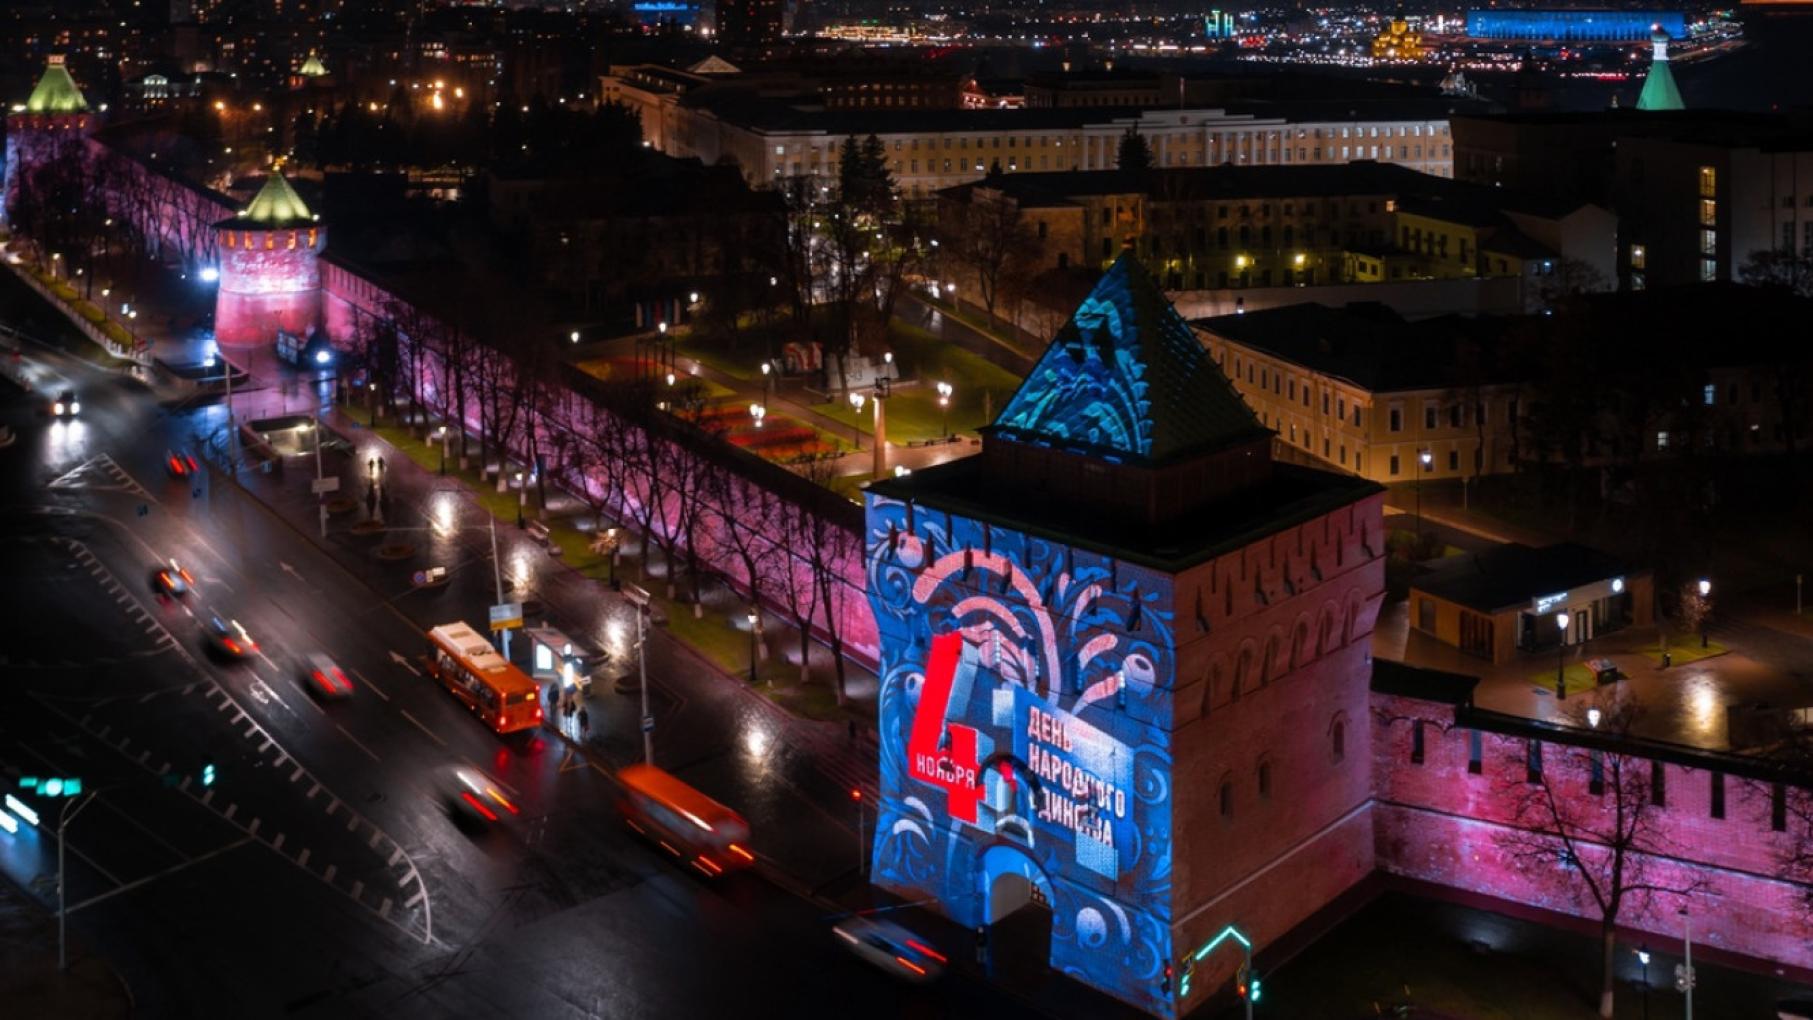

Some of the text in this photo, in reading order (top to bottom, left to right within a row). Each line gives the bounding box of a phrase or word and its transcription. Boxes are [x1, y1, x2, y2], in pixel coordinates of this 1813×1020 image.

[908, 630, 987, 825] 4
[1027, 705, 1073, 753] ДЕНЬ
[1028, 742, 1126, 818] НАРОДОГО
